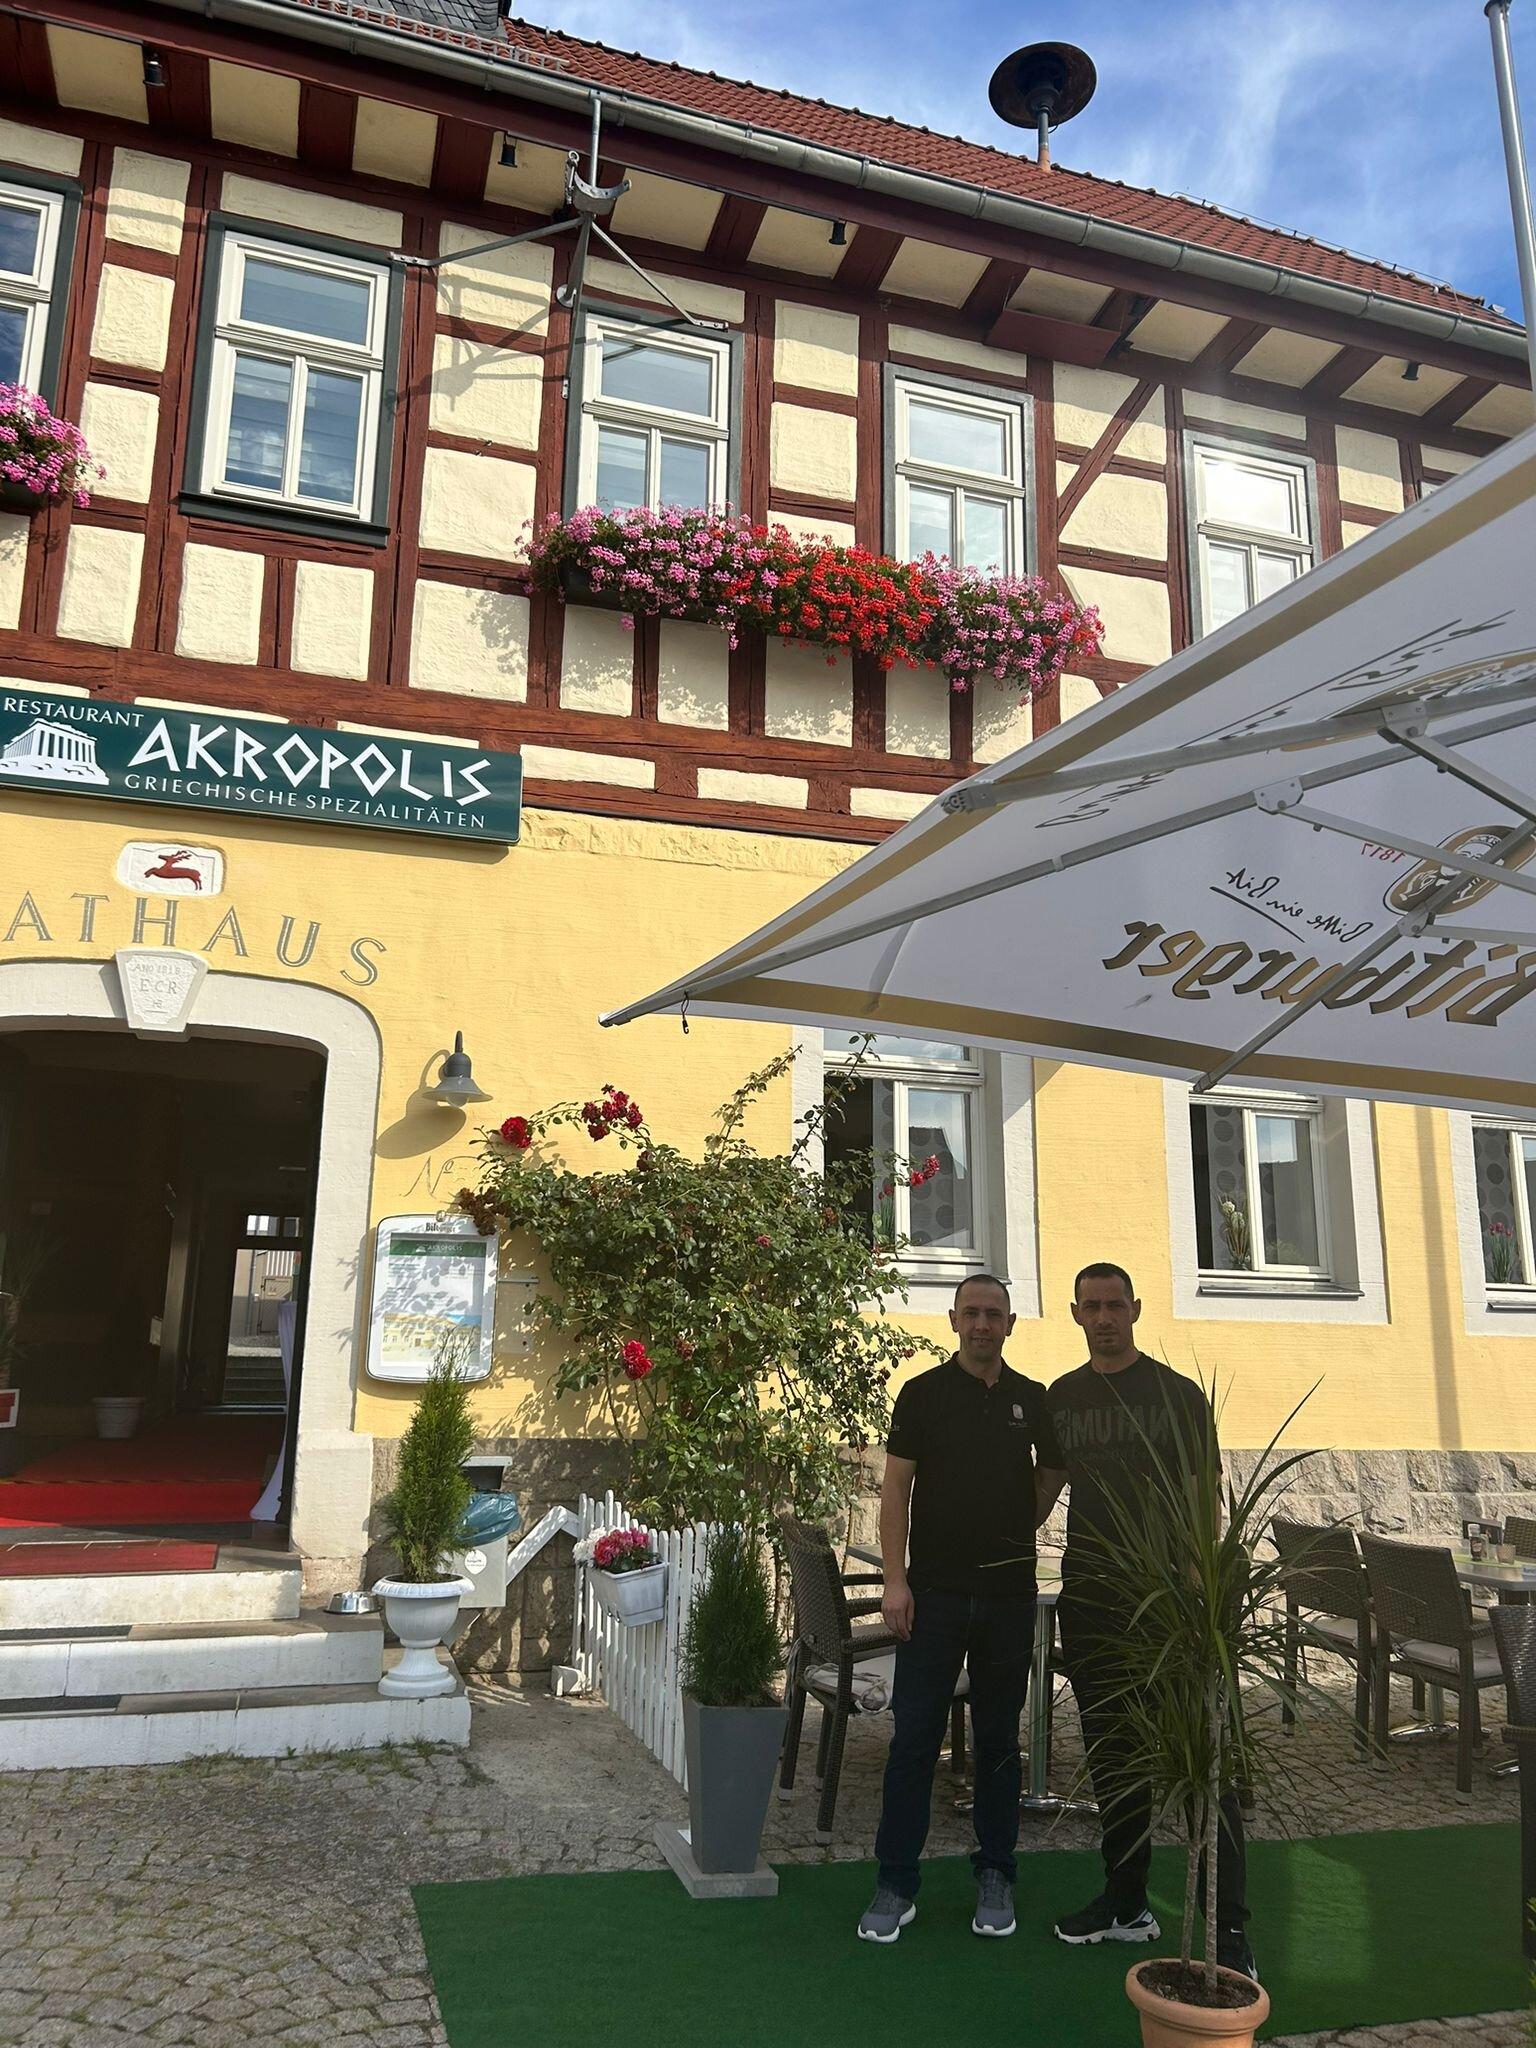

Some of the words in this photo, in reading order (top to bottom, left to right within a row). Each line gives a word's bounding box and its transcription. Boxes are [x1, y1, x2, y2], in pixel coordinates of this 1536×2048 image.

[4, 697, 144, 727] RESTAURANT
[128, 717, 491, 806] AKROPOLIS
[125, 773, 297, 807] GRIECHISCHE
[306, 794, 485, 829] SPEZIALITÄTEN
